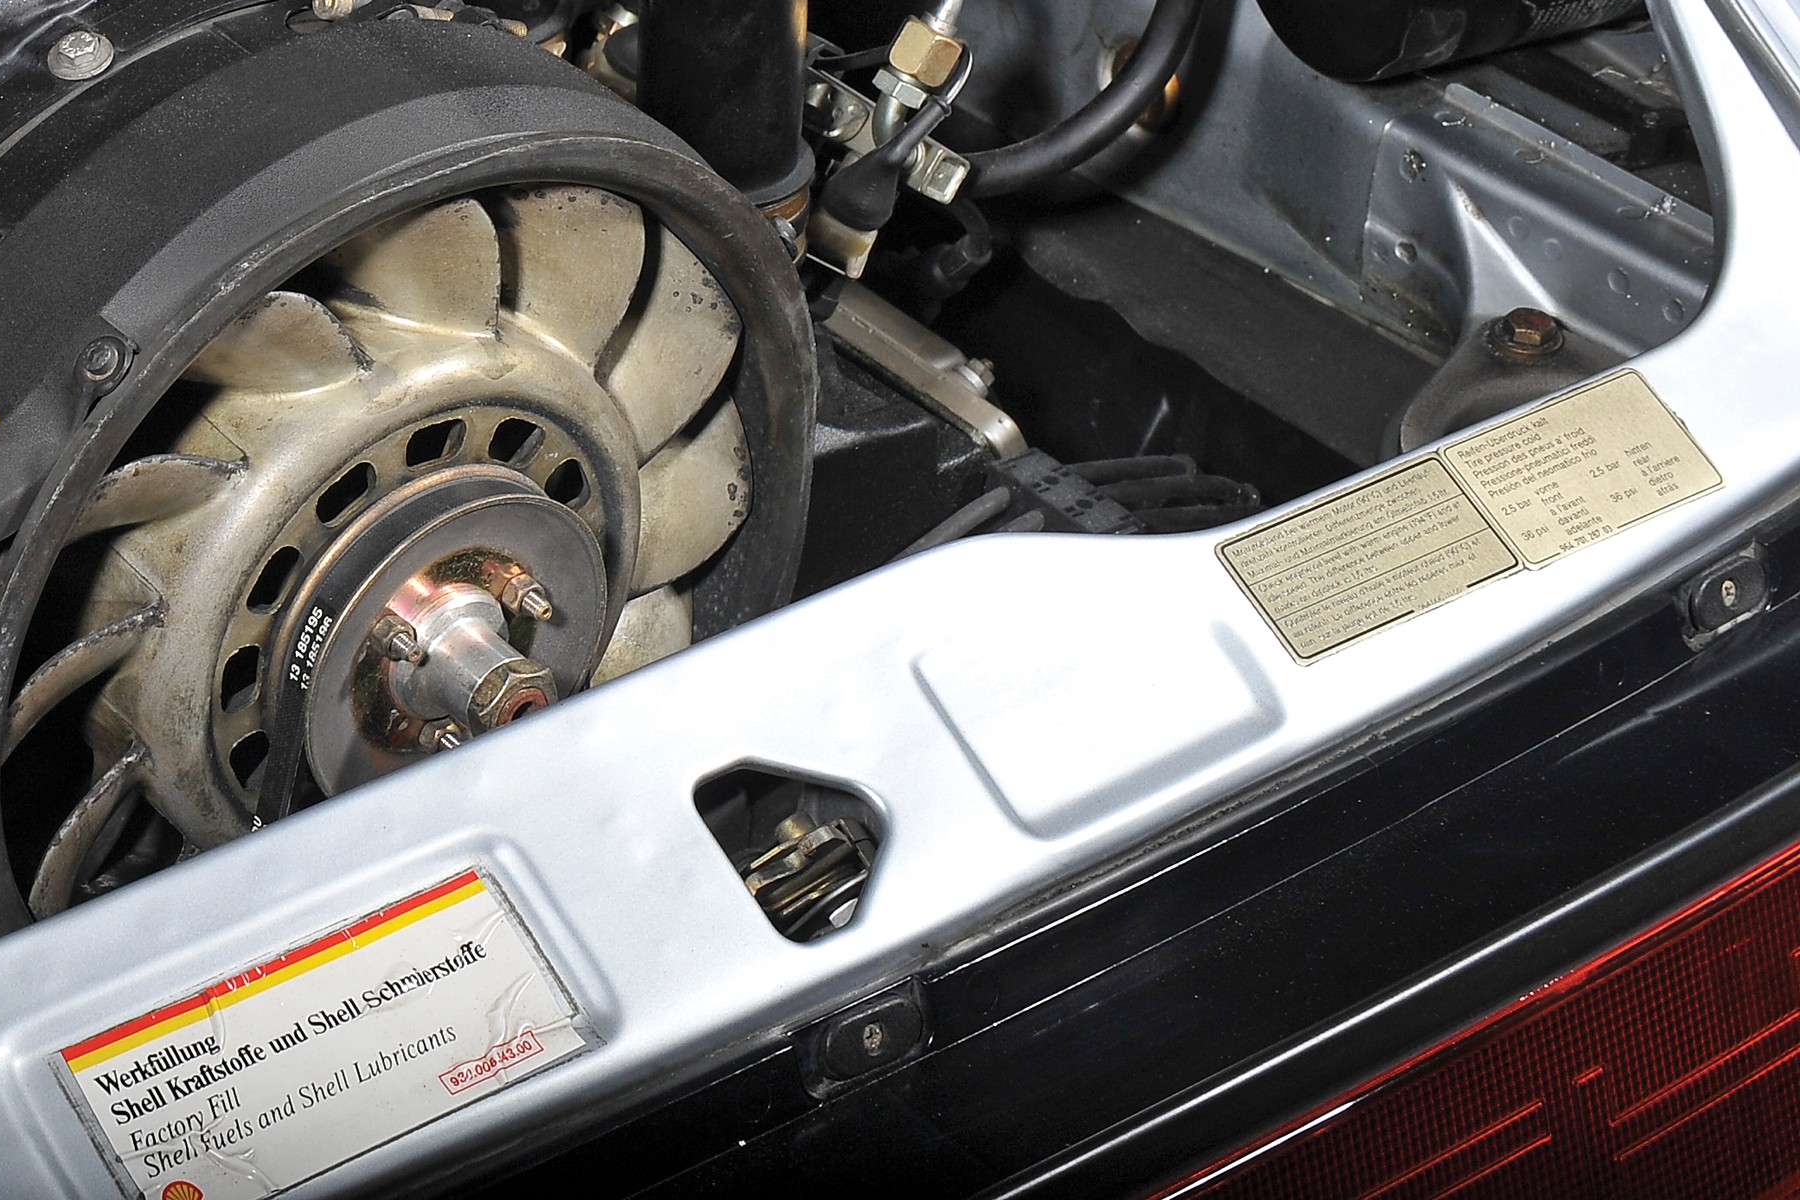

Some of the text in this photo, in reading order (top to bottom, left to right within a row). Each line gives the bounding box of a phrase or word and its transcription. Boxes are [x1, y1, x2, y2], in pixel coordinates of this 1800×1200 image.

[1529, 416, 1549, 428] kalt
[1463, 432, 1542, 469] Tire pressure cold
[1472, 426, 1585, 479] Pression des pneus froid
[1480, 434, 1596, 488] Pressione-pneumatici freddi
[1515, 498, 1532, 509] bar
[1534, 481, 1559, 495] vorne
[1604, 460, 1620, 471] bar
[1623, 441, 1652, 456] hinten
[1521, 472, 1537, 485] del
[1536, 455, 1582, 478] neomatico
[1520, 471, 1674, 541] 36 psi davanti 36 psi dietro
[1540, 454, 1650, 506] front rear
[1436, 504, 1452, 516] and
[1565, 515, 1603, 535] adelante
[289, 606, 323, 682] 13 185195
[110, 941, 485, 1124] Shell Kraftstoffe und Shell Schmierstoffe
[95, 1036, 220, 1093] Werkfüllung
[130, 1086, 240, 1157] Factory Fill
[143, 1026, 456, 1178] Shell Fuels and Shell Lubricants
